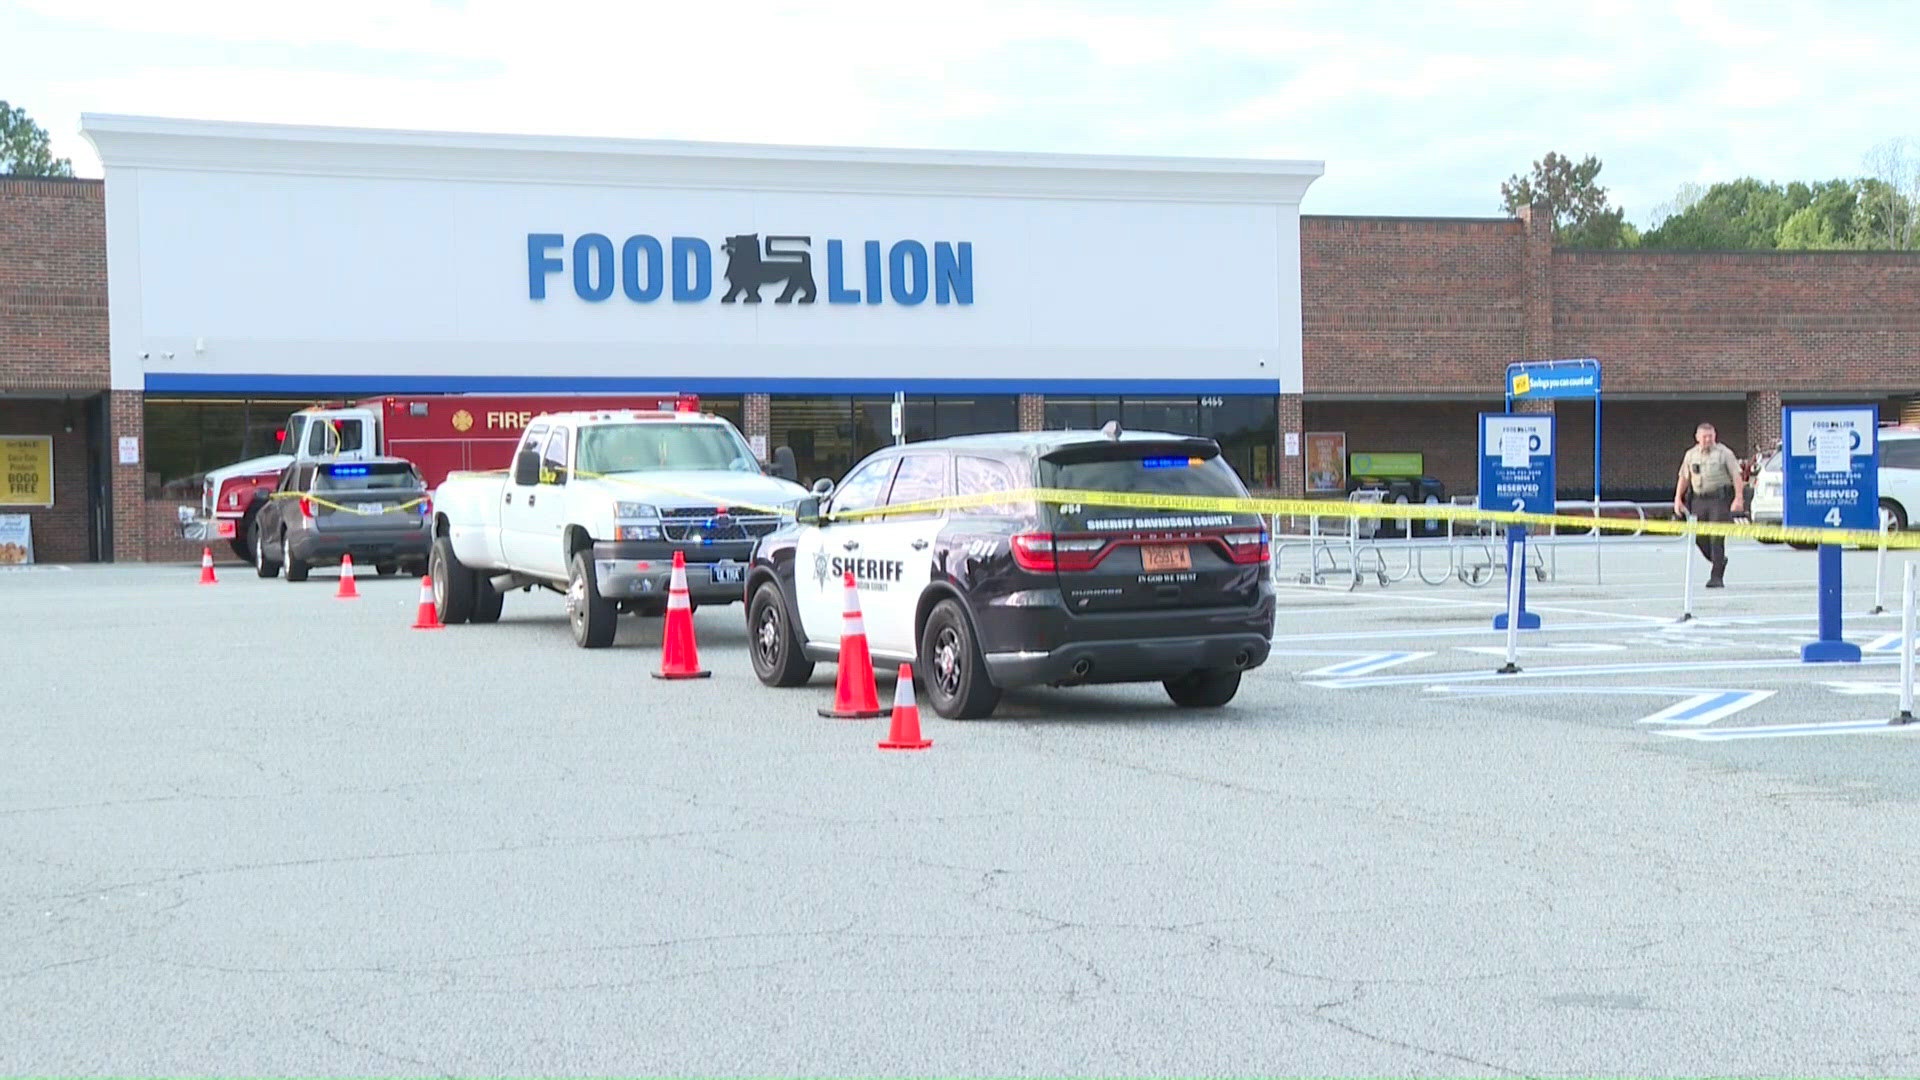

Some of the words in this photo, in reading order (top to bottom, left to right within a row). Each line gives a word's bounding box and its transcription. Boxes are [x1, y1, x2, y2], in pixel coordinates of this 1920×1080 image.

[527, 232, 712, 303] FOOD
[827, 238, 974, 306] LION
[1530, 376, 1550, 391] Savings
[1550, 378, 1560, 391] you
[486, 410, 532, 430] FIRE
[8, 473, 39, 483] BOGO
[10, 483, 37, 494] FREE
[1496, 483, 1539, 492] RESERVED
[1806, 489, 1859, 499] RESERVED
[1512, 498, 1526, 512] 2
[1087, 518, 1133, 530] SHERIFF
[1136, 517, 1192, 529] DAVIDSON
[1193, 515, 1234, 527] COUNTY
[1824, 507, 1842, 527] 4
[969, 539, 999, 558] 911
[832, 556, 903, 583] SHERIFF
[1138, 574, 1146, 583] IN
[1147, 573, 1163, 582] GOD
[1164, 573, 1174, 582] WE
[1176, 572, 1197, 582] TRUST
